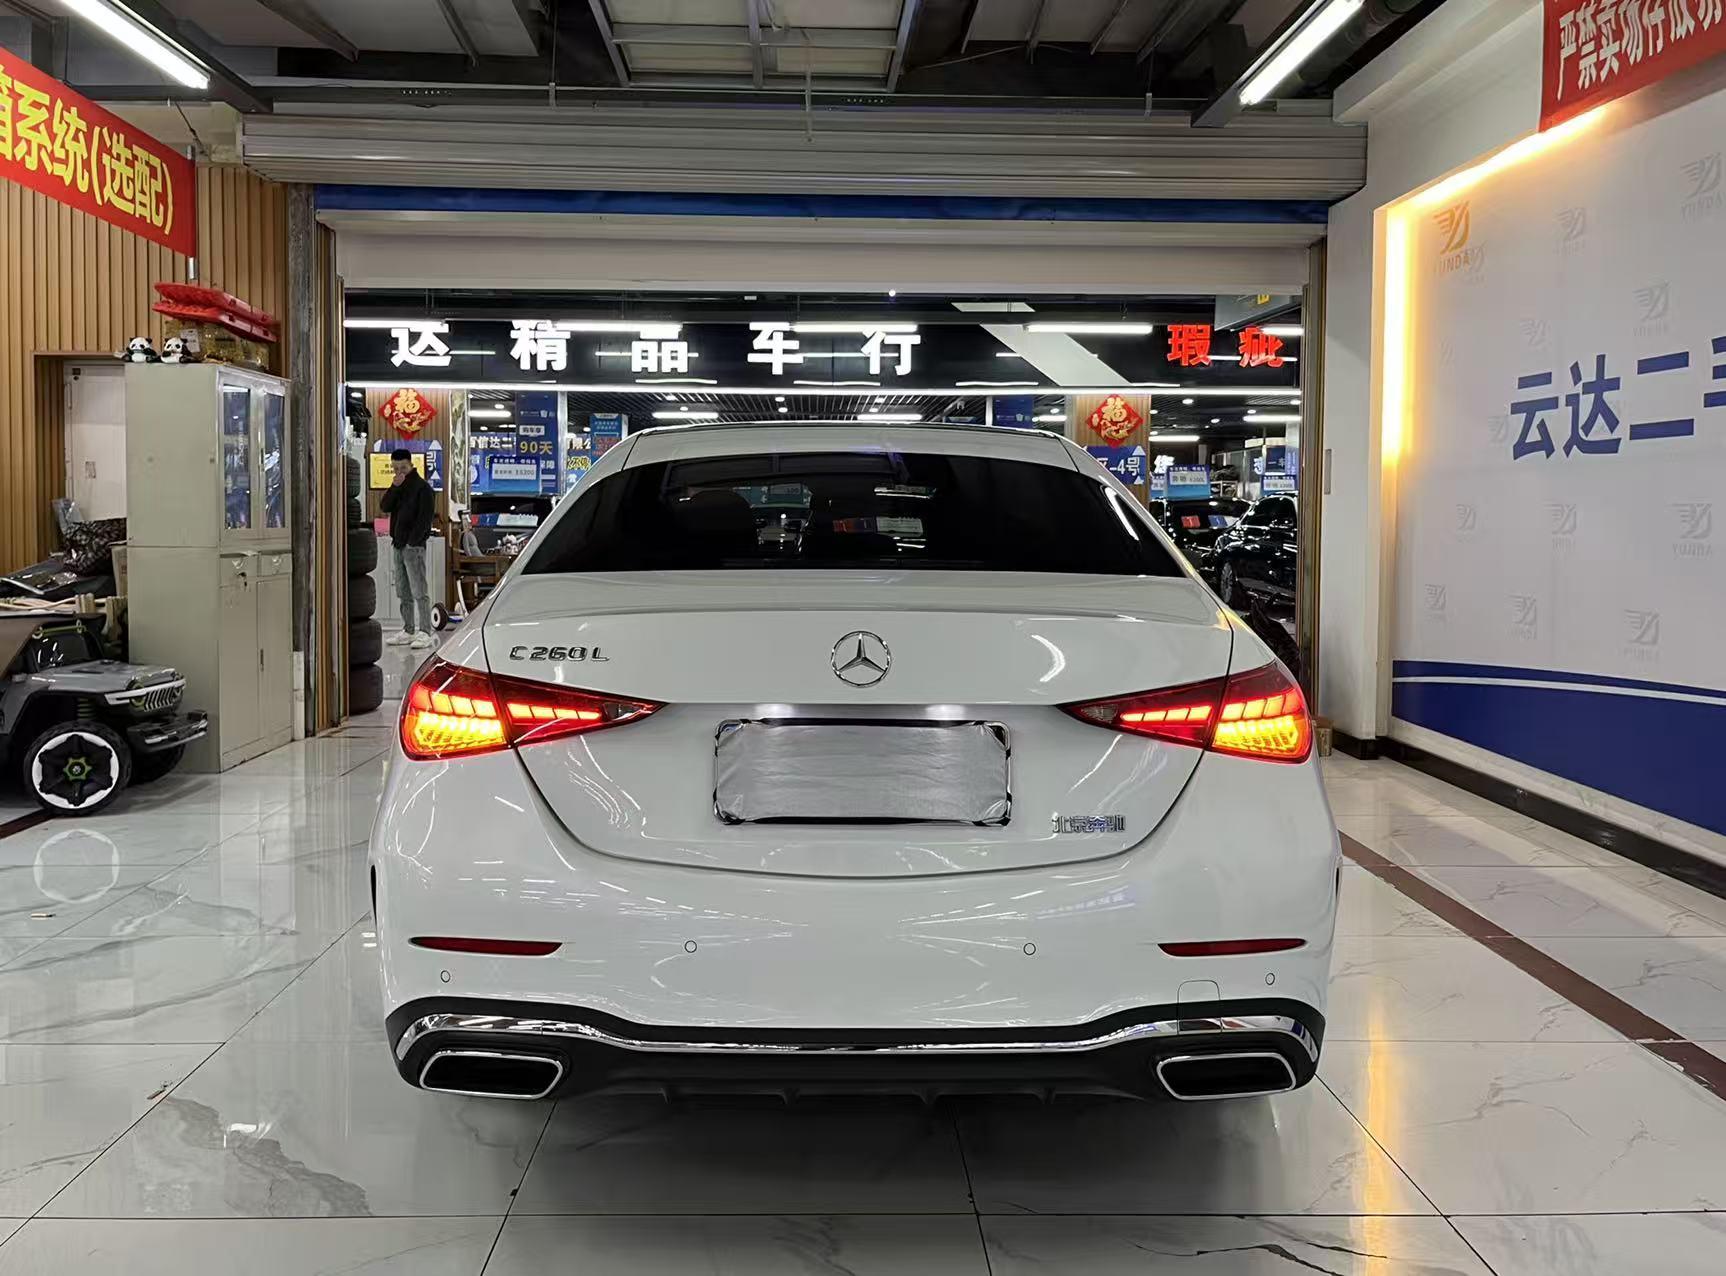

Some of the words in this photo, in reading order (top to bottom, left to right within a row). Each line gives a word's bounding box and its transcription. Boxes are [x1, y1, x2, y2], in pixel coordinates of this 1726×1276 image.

[1167, 324, 1284, 367] 瑕疵
[393, 387, 420, 414] 福
[1101, 396, 1128, 422] 福
[520, 441, 553, 455] 90天
